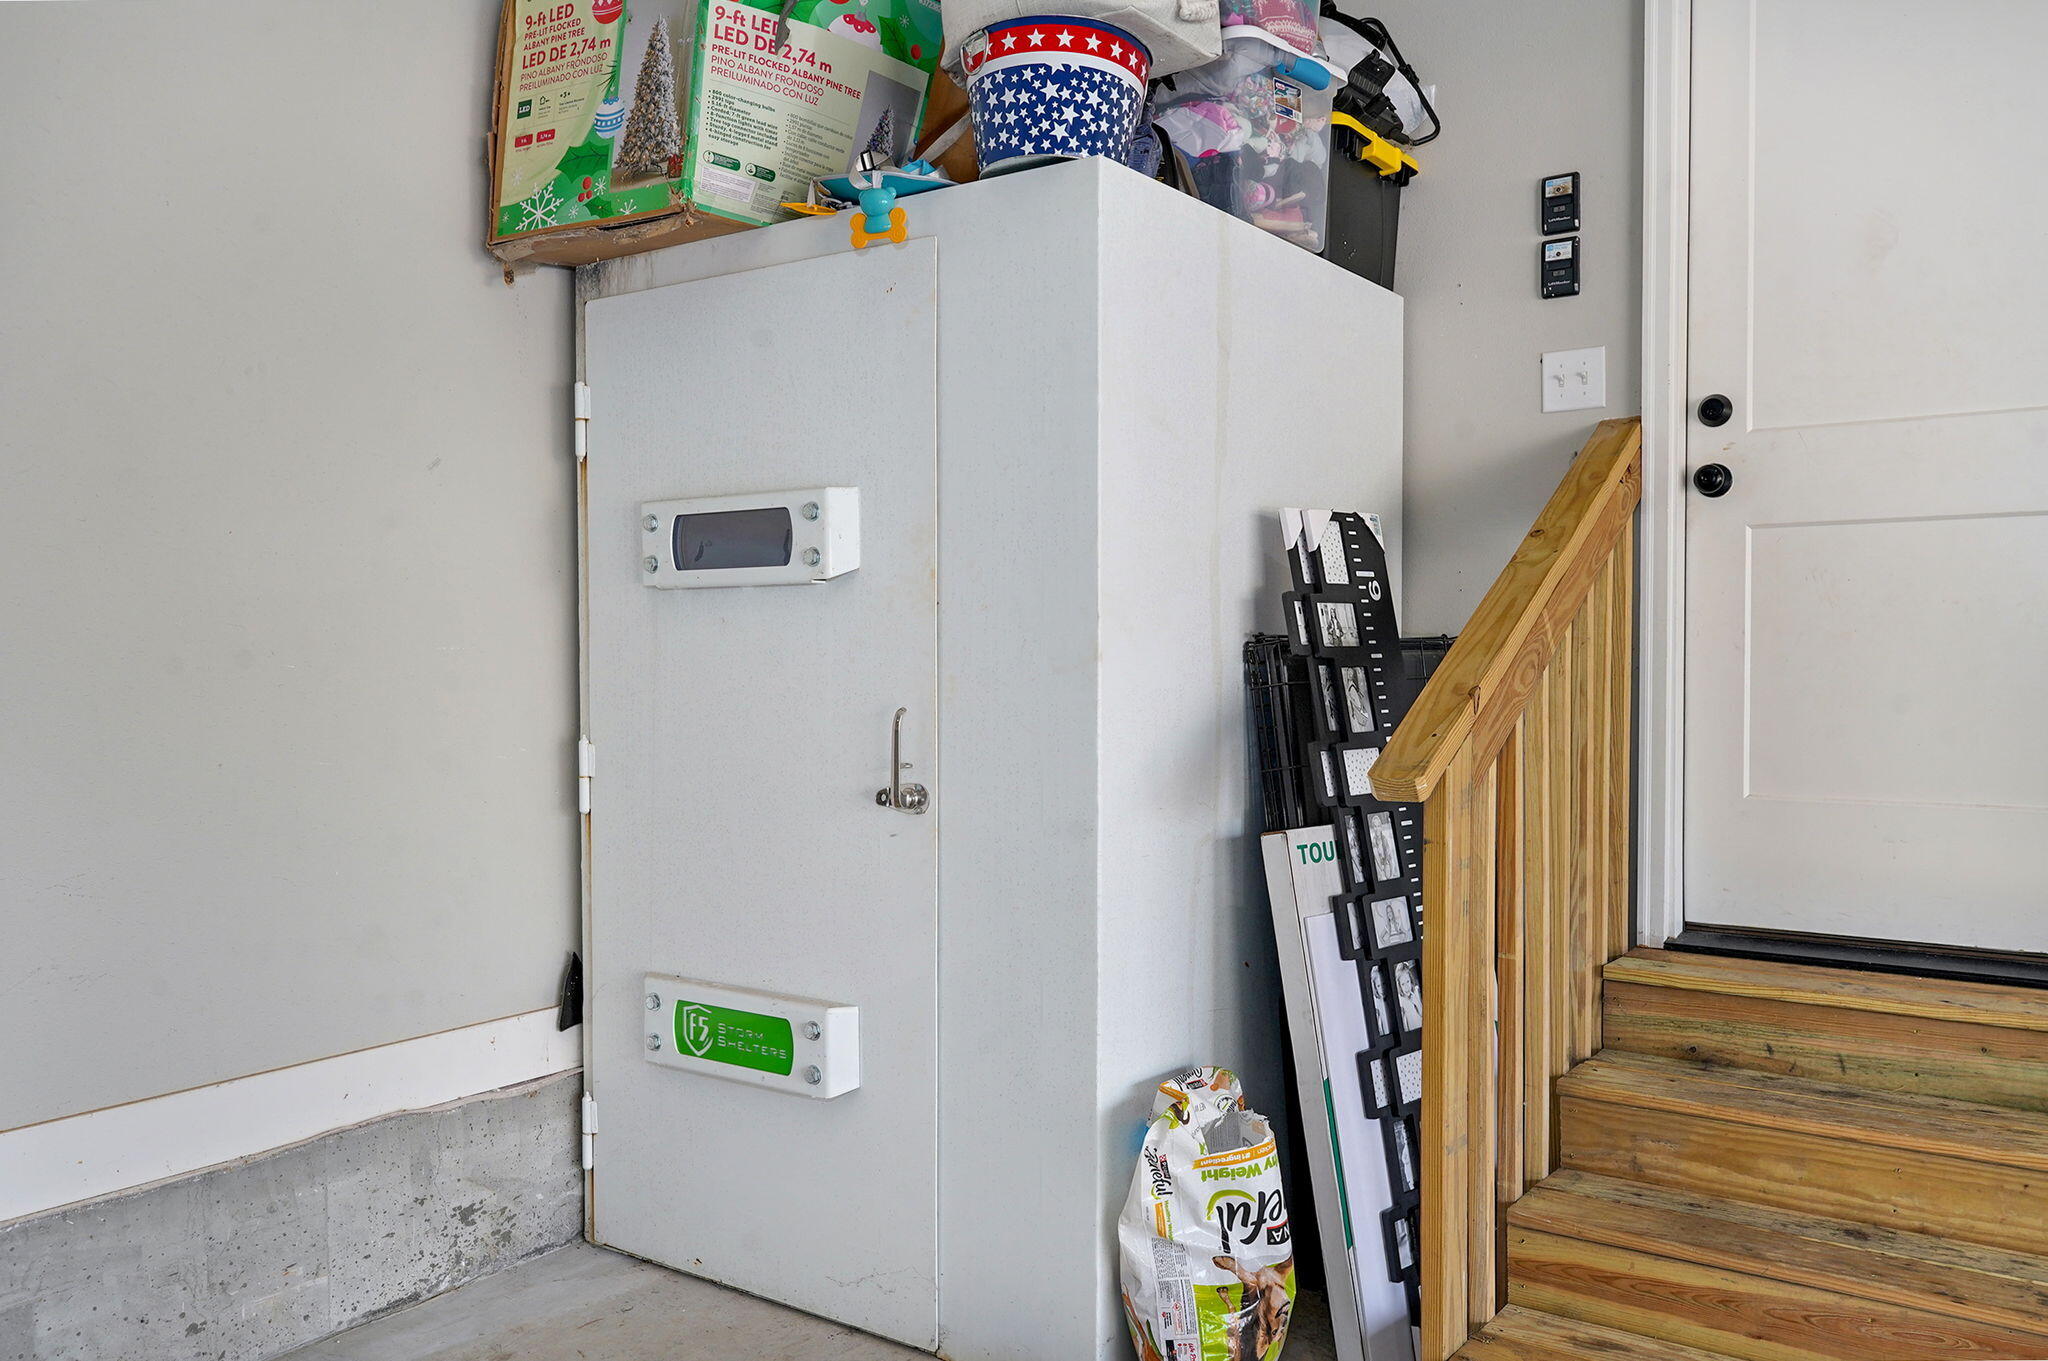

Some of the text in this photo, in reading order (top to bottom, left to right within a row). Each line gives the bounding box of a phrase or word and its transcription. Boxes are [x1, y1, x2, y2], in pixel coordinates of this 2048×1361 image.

[524, 18, 581, 40] PRE-LIT FLOCKED
[526, 3, 574, 30] 9-ft LED
[715, 6, 746, 27] 9-ft
[523, 27, 585, 51] ALBANY PINE TREE
[714, 24, 832, 74] LED DE 2,74 m
[520, 52, 608, 81] PINO ALBANY FRONDOSO
[522, 37, 611, 70] LED DE 2,74 m
[519, 64, 604, 92] PREILUMINADO CON LUZ
[711, 44, 863, 100] PRE-LIT FLOCKED ALBANY PINE TREE
[711, 55, 824, 96] PINO ALBANY FRONDOSO
[711, 66, 820, 107] PREILUMINADO CON LUZ
[717, 1022, 765, 1040] STORM
[717, 1035, 788, 1060] SHELTERS
[1201, 1163, 1262, 1182] Weight
[1216, 1189, 1283, 1254] eful
